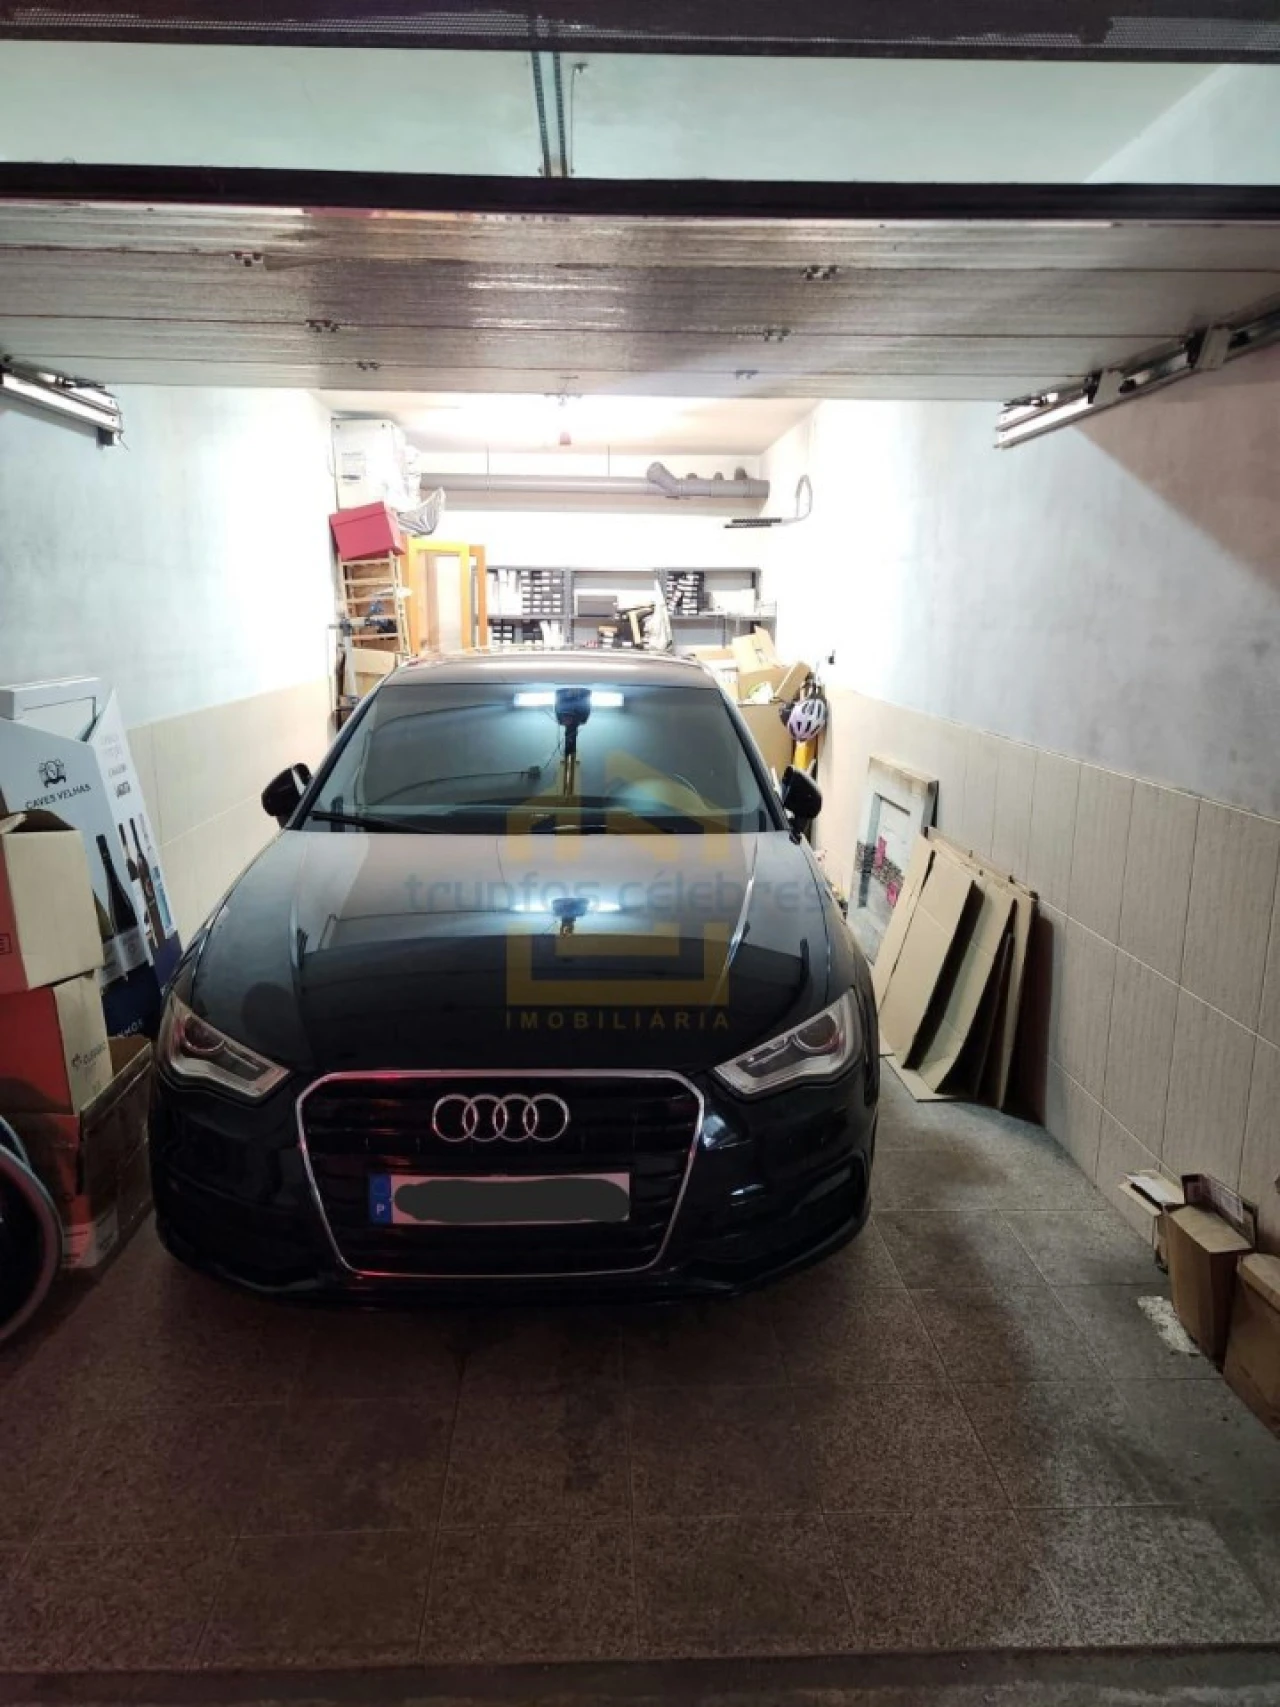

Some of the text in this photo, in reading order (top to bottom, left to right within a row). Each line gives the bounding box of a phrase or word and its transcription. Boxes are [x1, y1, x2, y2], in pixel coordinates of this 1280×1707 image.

[25, 784, 92, 810] CAVES VELHAS
[376, 1203, 385, 1216] P
